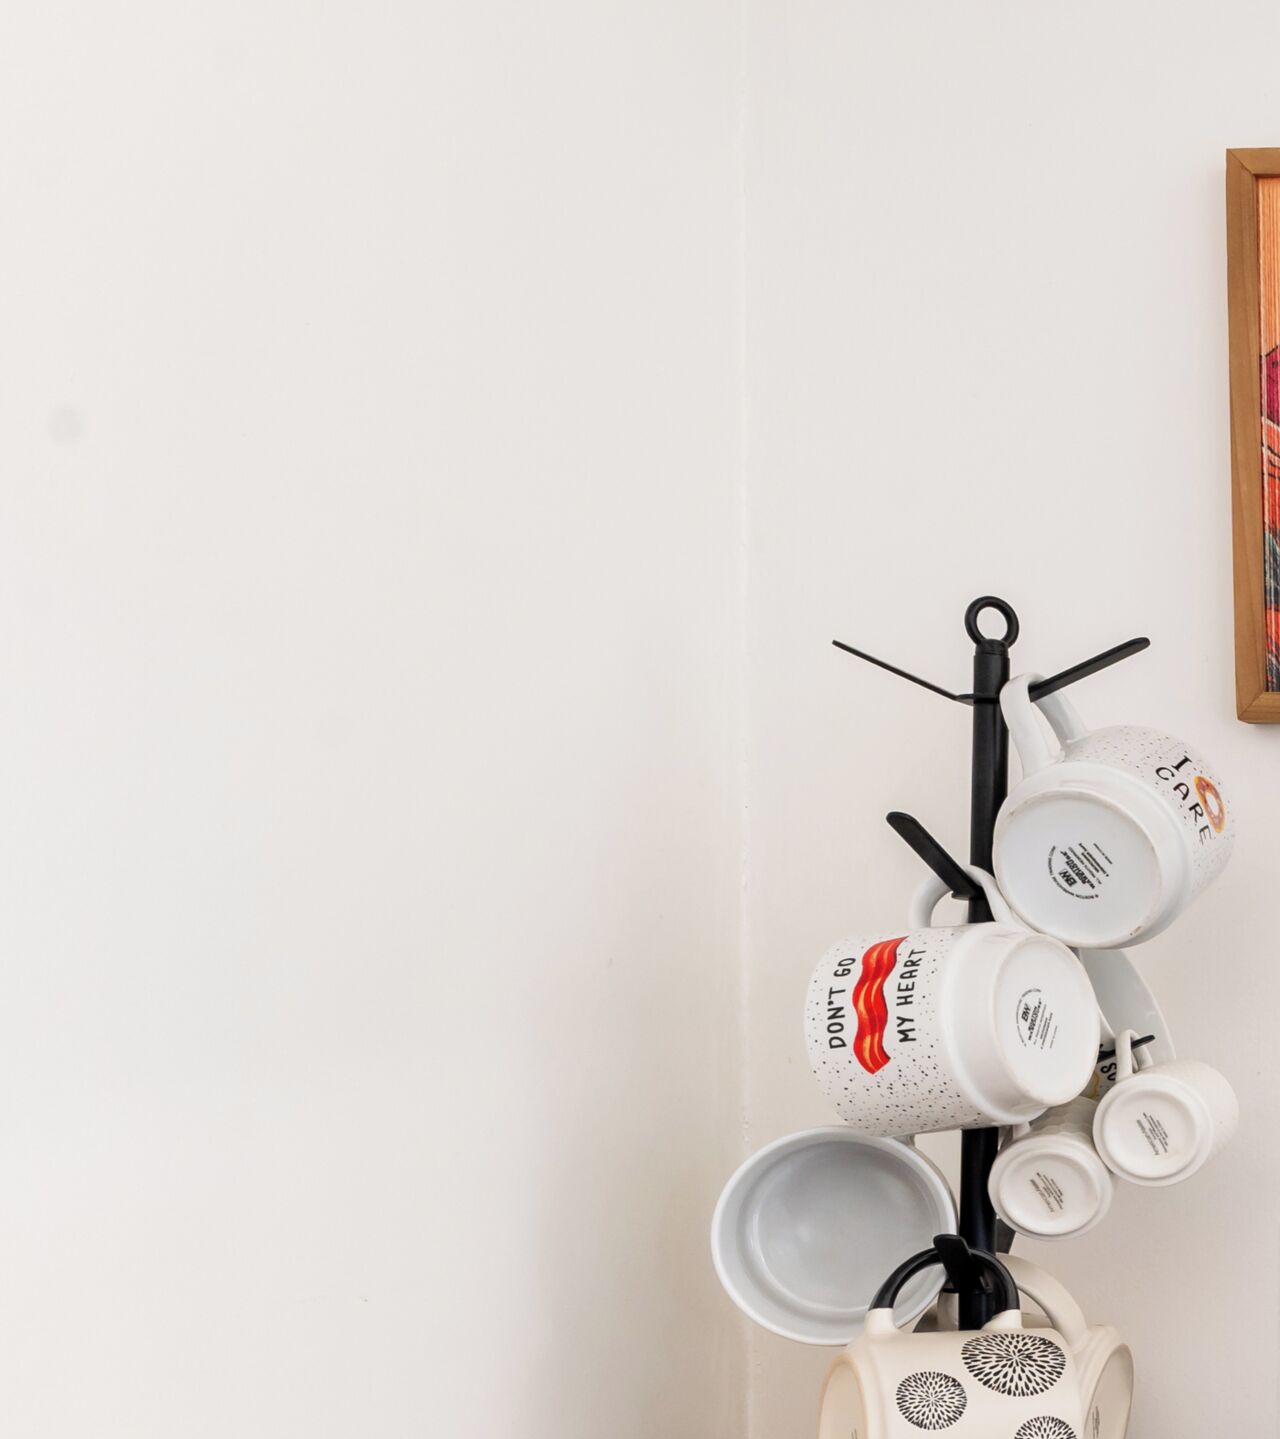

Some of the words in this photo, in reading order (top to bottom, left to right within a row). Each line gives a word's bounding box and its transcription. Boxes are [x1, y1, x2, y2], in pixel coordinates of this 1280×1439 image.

[1171, 755, 1192, 772] I
[1155, 767, 1211, 845] CARE
[833, 958, 856, 977] GO
[896, 949, 926, 1006] HEART
[827, 987, 847, 1049] DON'T
[896, 1016, 917, 1042] MY
